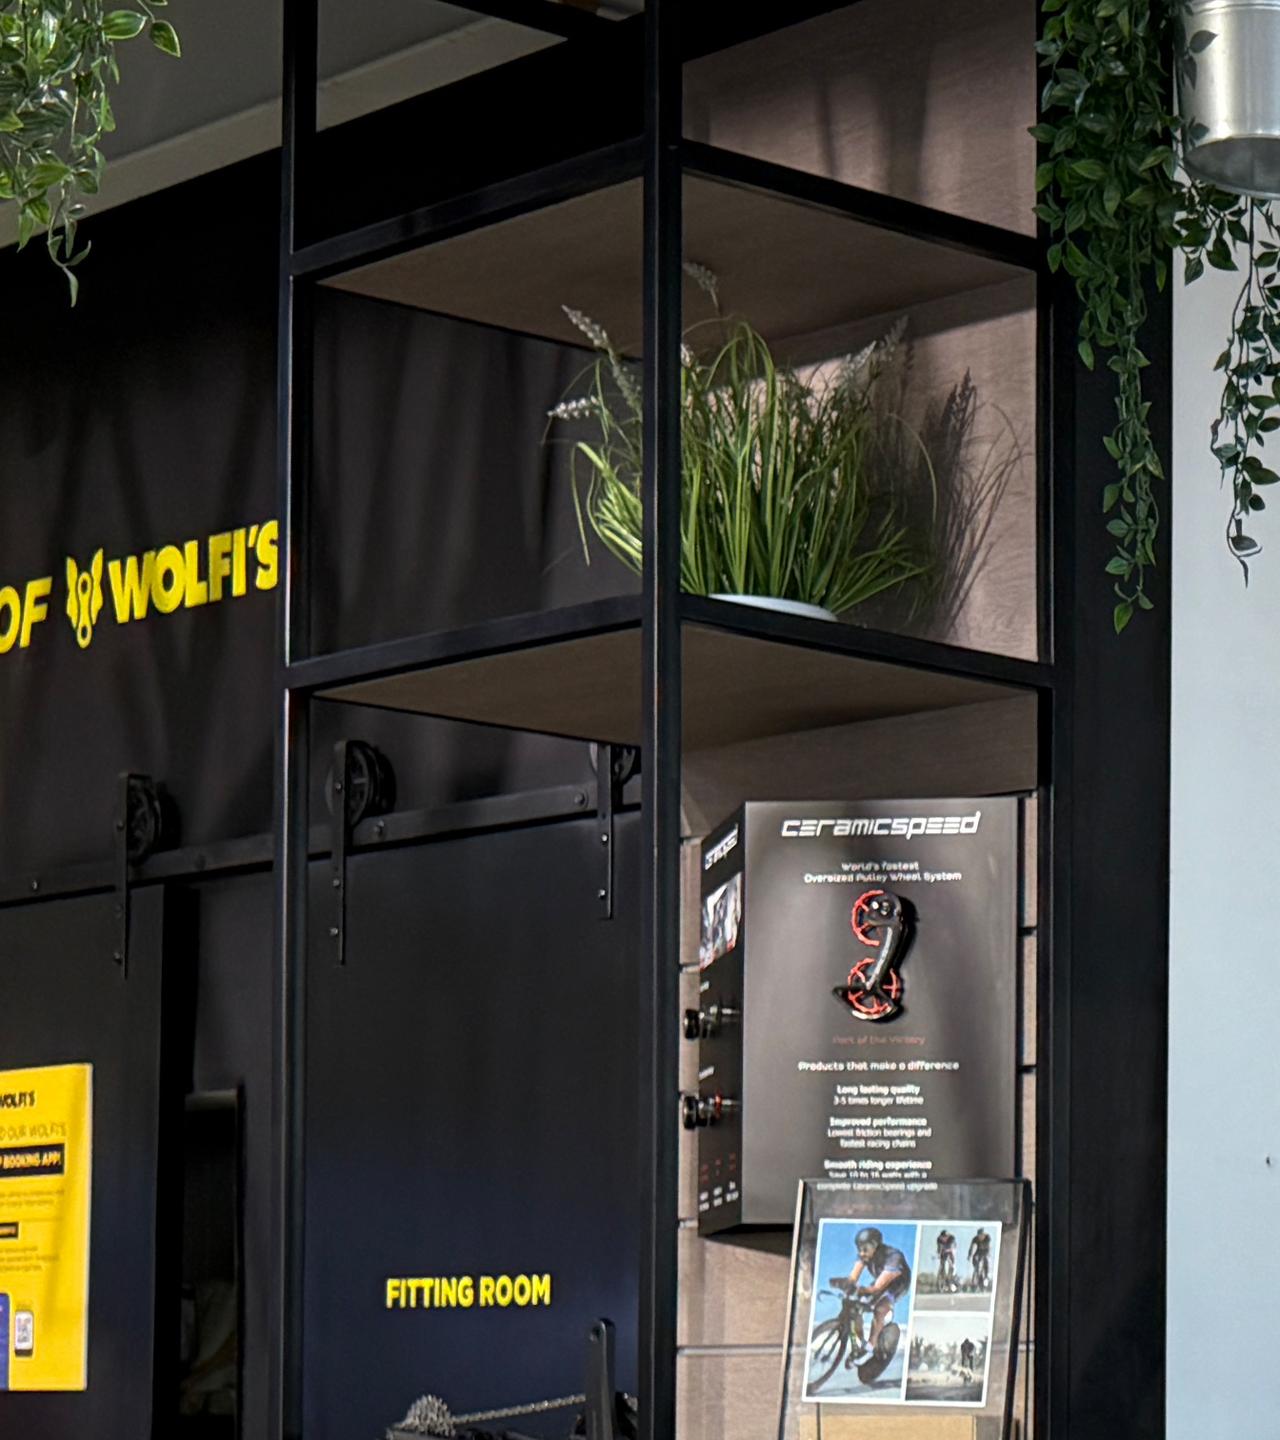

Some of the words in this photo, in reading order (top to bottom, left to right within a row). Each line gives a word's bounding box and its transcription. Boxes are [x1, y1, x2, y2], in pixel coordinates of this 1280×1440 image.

[0, 577, 52, 654] OF
[108, 520, 279, 624] WOLFI'S
[798, 1061, 844, 1071] Products
[846, 1061, 869, 1071] that
[907, 1060, 960, 1071] difference
[386, 1276, 475, 1309] FITTING
[479, 1274, 552, 1307] ROOM
